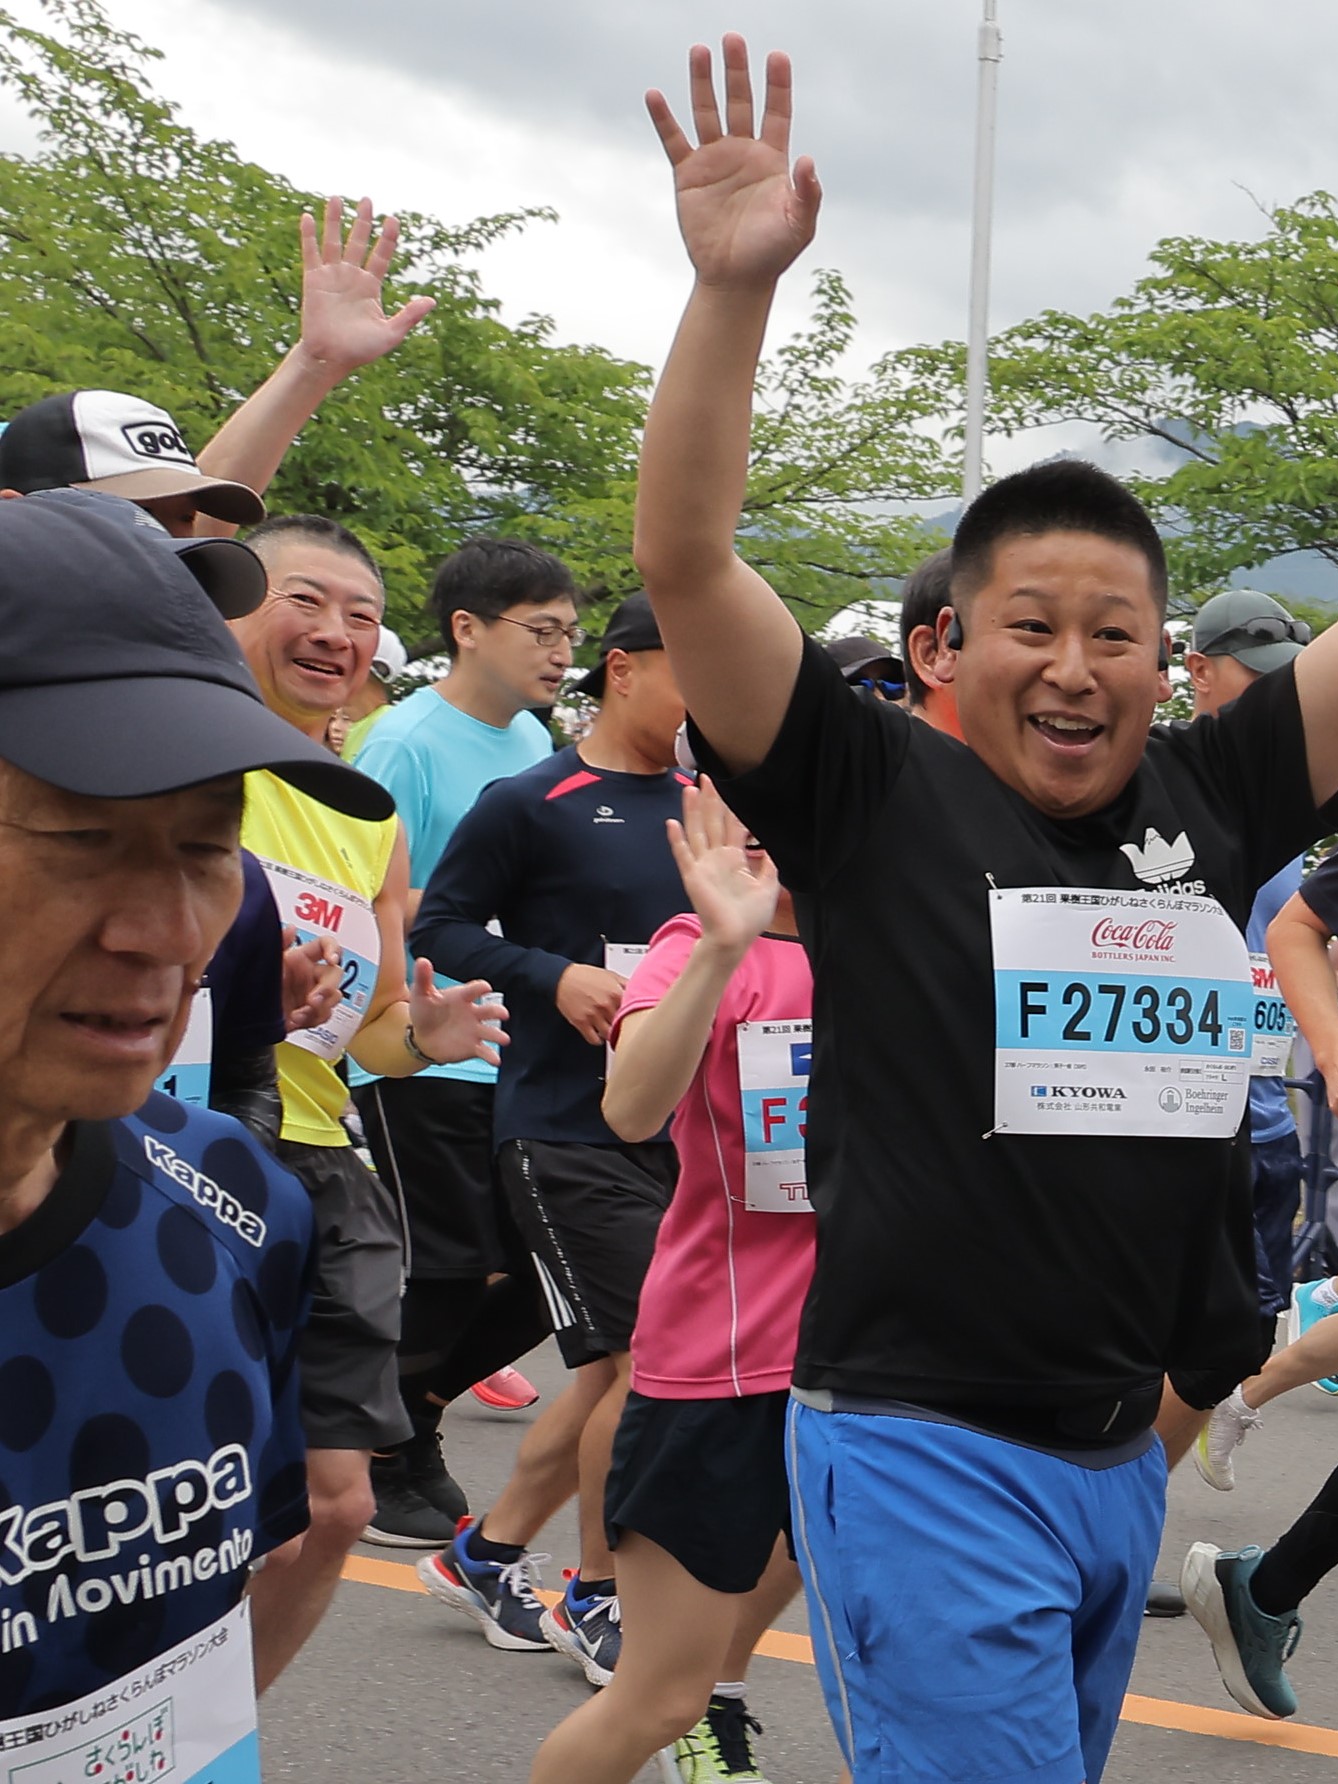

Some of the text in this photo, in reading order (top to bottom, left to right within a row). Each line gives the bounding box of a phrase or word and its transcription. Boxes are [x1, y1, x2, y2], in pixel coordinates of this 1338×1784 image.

[1021, 893, 1057, 905] 第21回
[294, 892, 344, 933] 3M
[1091, 951, 1134, 962] BOTTLERS
[1135, 953, 1160, 963] JAPAN
[1051, 1086, 1128, 1099] KYOWA
[1185, 1087, 1229, 1102] Boehringer
[1036, 1102, 1072, 1112] 株式会社
[1185, 1102, 1224, 1115] Ingelheim
[144, 1134, 267, 1248] Kappa
